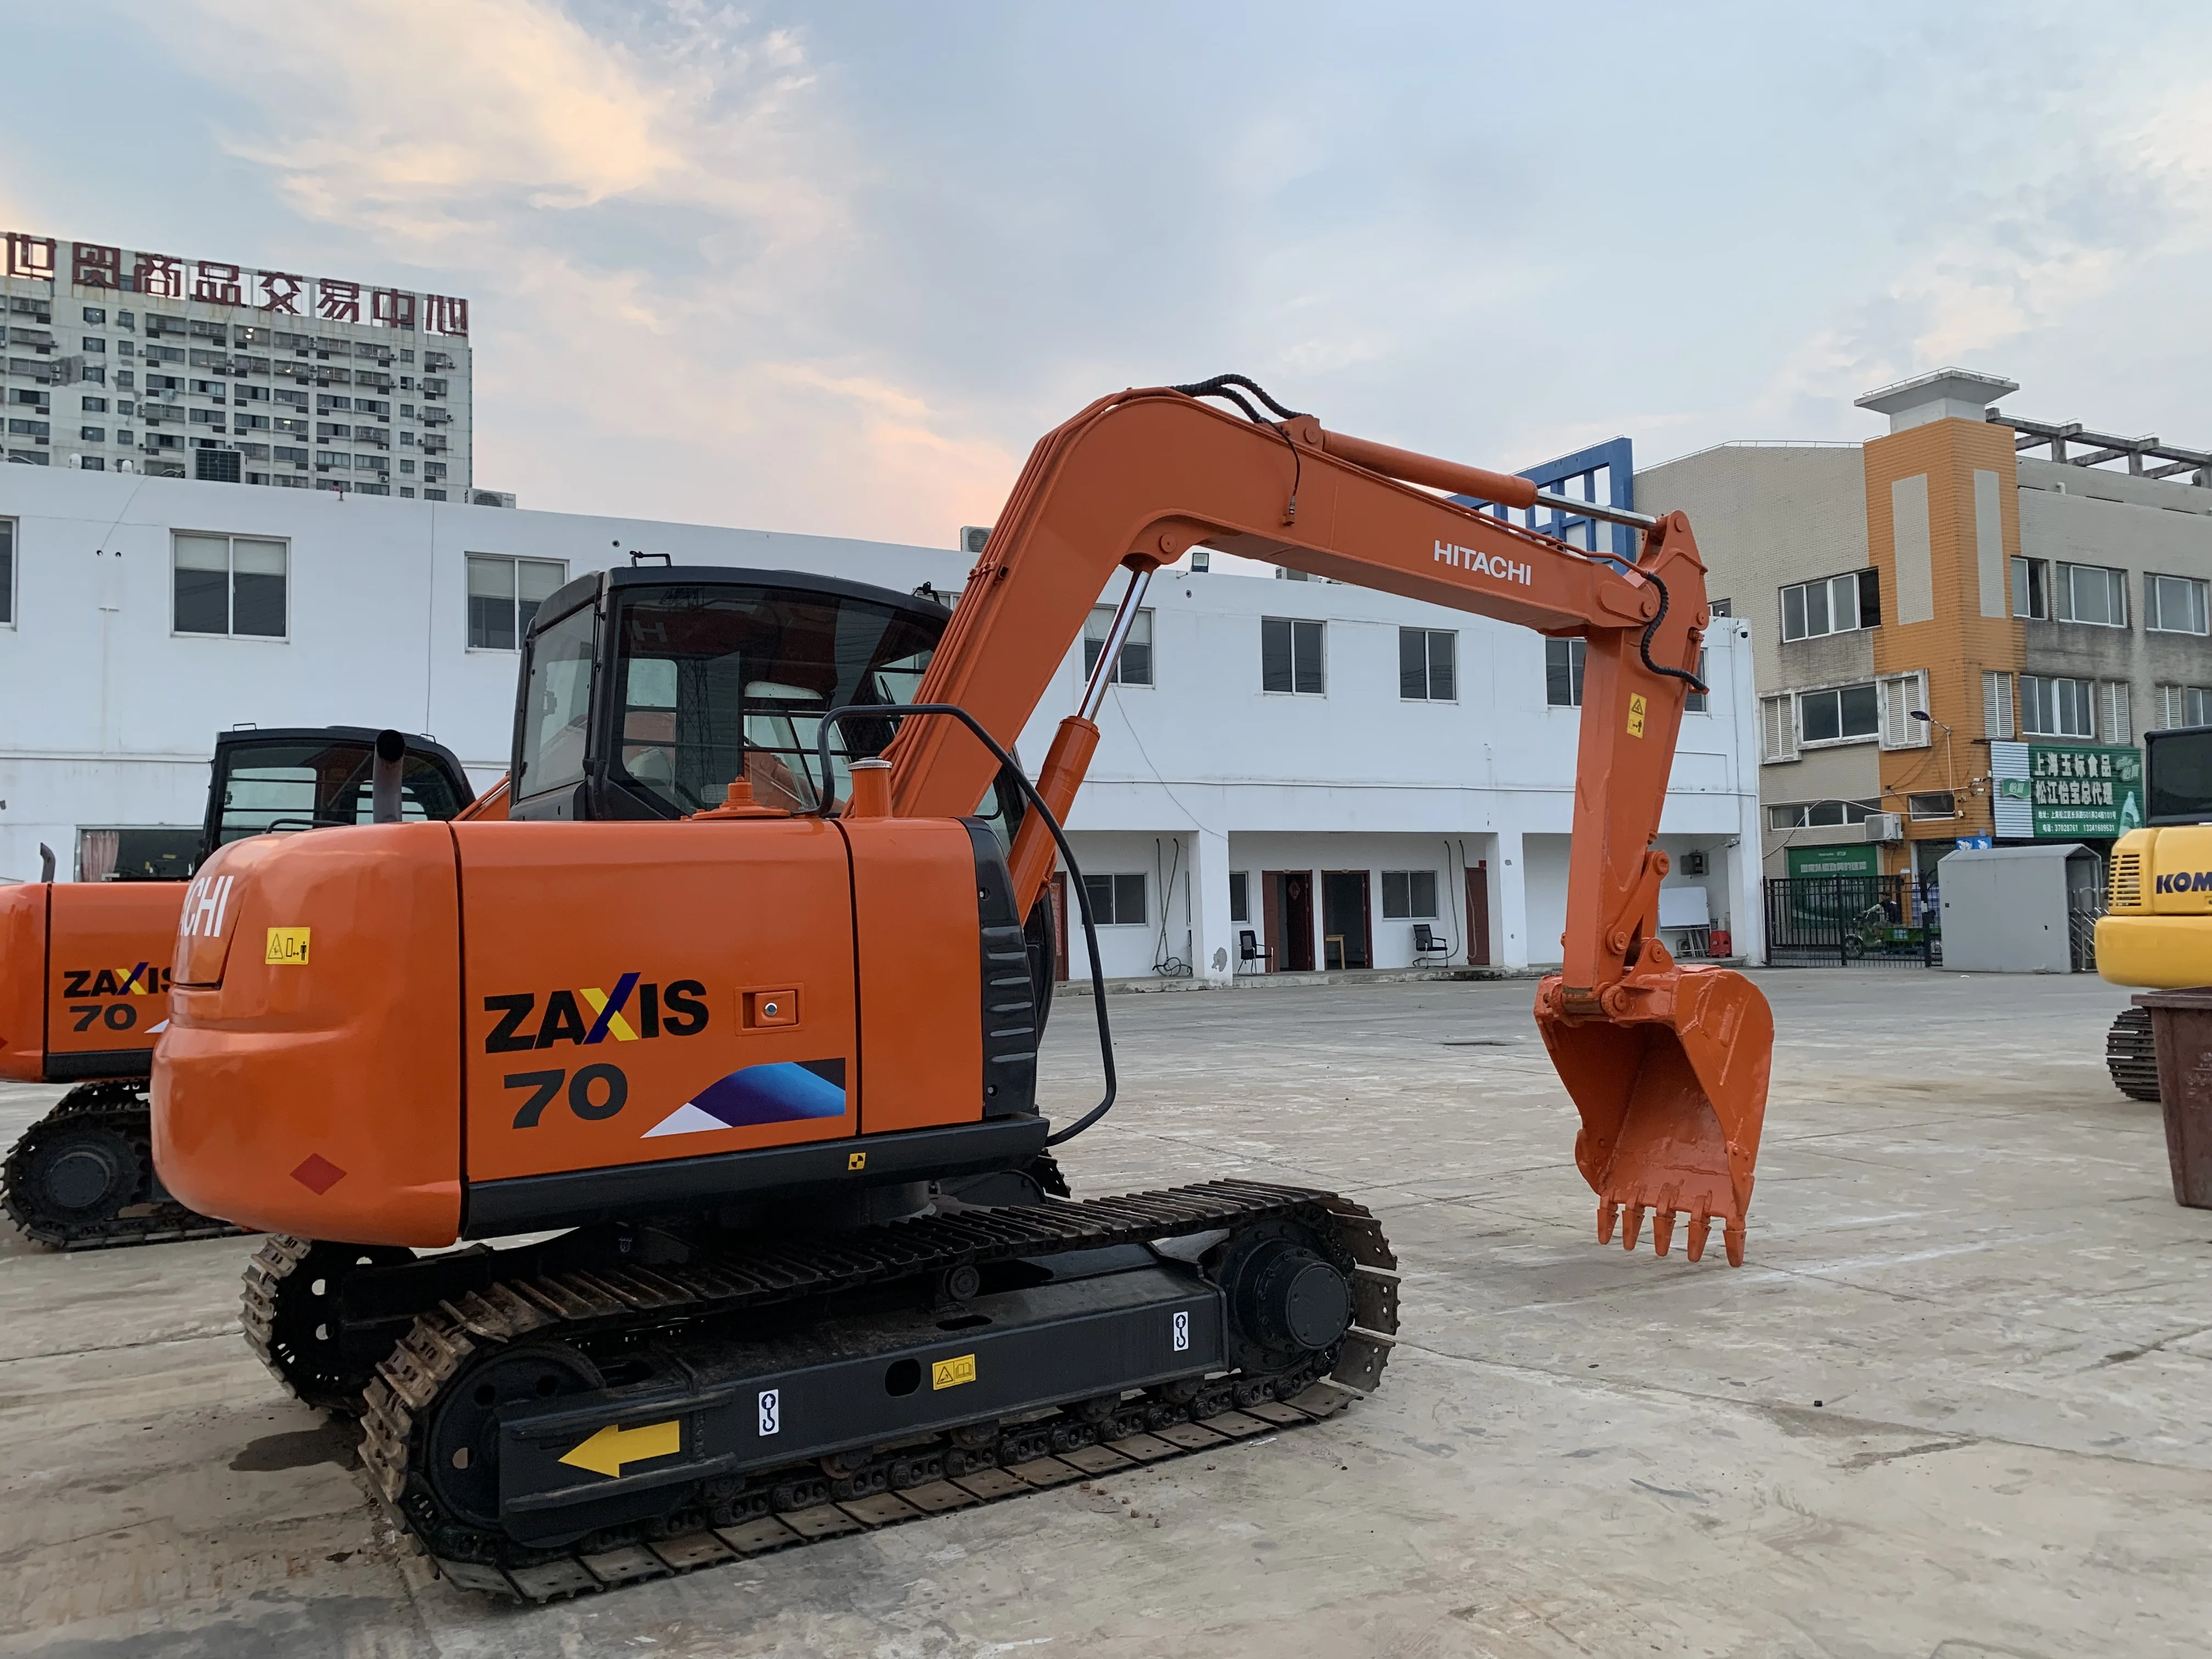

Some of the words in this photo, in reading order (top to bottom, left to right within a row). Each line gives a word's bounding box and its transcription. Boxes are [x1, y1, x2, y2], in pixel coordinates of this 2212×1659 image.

[5, 232, 467, 337] 世贸商品交易中心
[1434, 540, 1531, 586] HITACHI
[2036, 780, 2113, 806] 松江怡宝总代理
[178, 876, 234, 938] CHI
[2156, 872, 2212, 894] KOM
[70, 1003, 137, 1031] 70
[484, 972, 709, 1054] ZAXIS
[504, 1063, 628, 1129] 70
